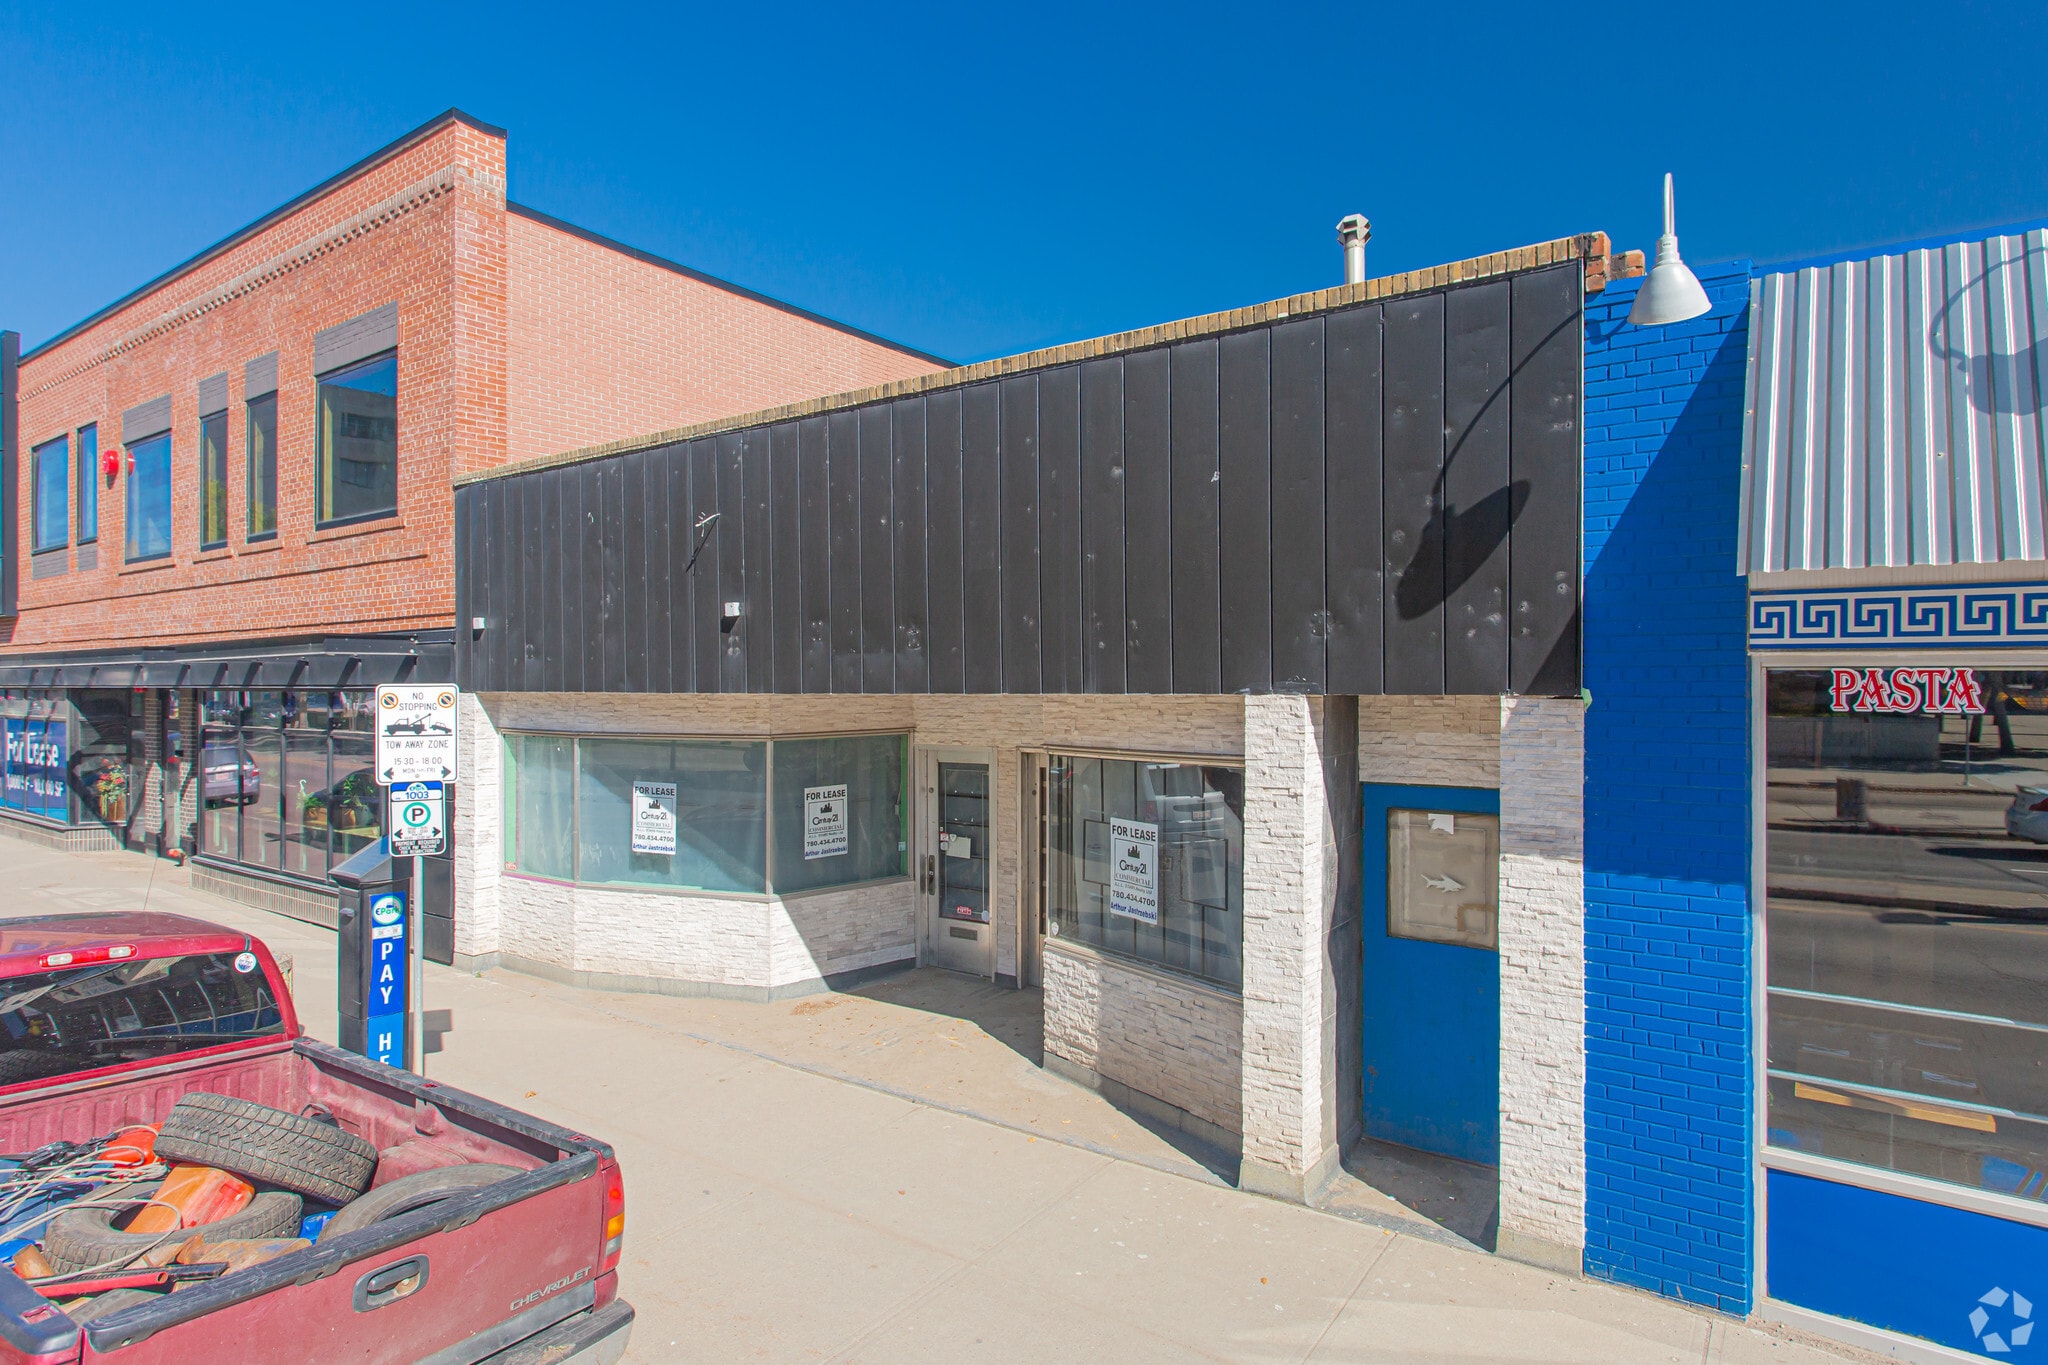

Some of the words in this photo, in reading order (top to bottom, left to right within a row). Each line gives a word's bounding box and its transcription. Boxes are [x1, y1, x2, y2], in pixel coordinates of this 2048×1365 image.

[1829, 667, 1986, 713] PASTA
[412, 692, 424, 700] NO
[399, 702, 437, 711] STOPPING
[6, 732, 24, 762] For
[26, 733, 59, 767] Lease
[386, 741, 402, 749] TOW
[405, 740, 424, 749] AWAY
[428, 740, 448, 748] ZONE
[405, 791, 429, 799] 1003
[634, 786, 649, 794] FOR
[651, 787, 675, 796] LEASE
[806, 792, 821, 801] FOR
[823, 789, 846, 799] LEASE
[641, 811, 660, 820] Century
[812, 816, 831, 825] Century
[634, 834, 674, 842] 780.434.4700
[1112, 824, 1128, 837] FOR
[1130, 827, 1156, 842] LEASE
[806, 837, 846, 847] 780.434.4700
[1119, 859, 1140, 874] Century
[1115, 873, 1152, 886] COMMERCIAL
[1112, 890, 1156, 907] 780.434.4700
[1111, 901, 1127, 912] Arthur
[379, 941, 394, 1005] PAY
[510, 1266, 592, 1311] CHEVROLET
